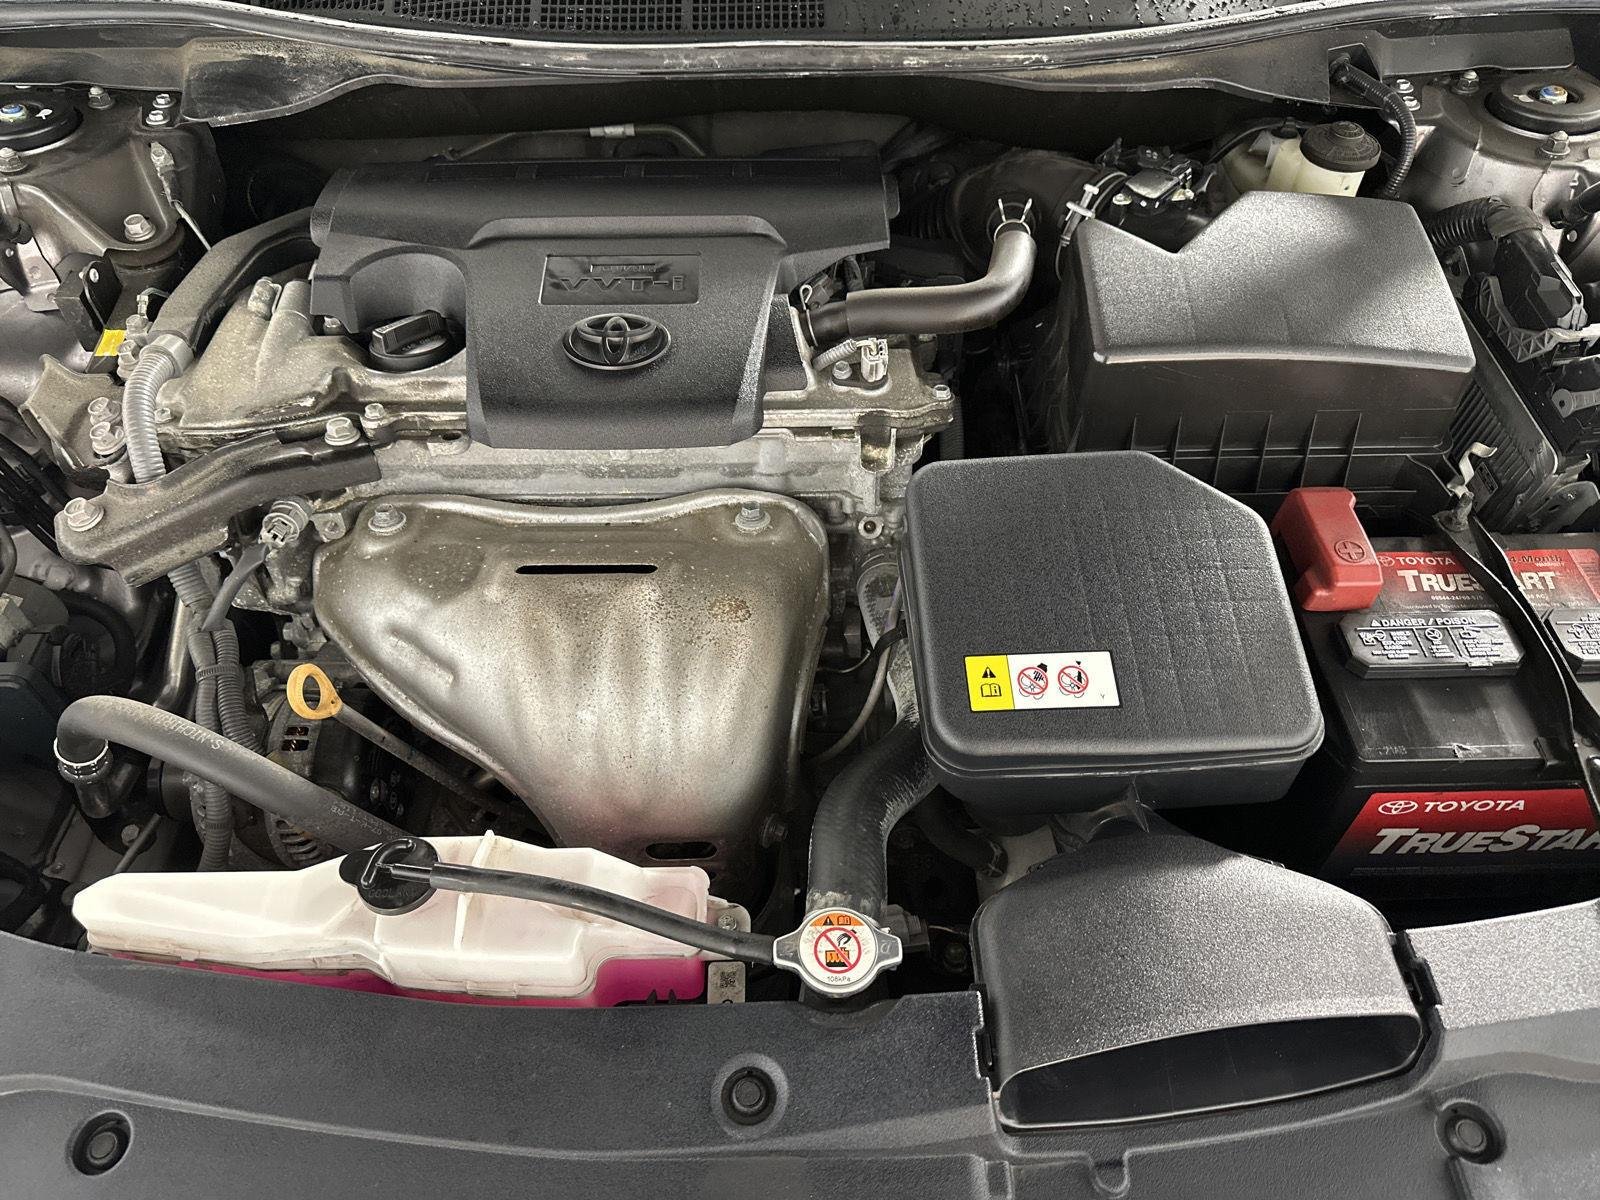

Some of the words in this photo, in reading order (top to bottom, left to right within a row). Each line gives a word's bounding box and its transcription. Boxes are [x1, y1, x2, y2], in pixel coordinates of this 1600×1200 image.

[560, 276, 686, 292] VVT-i
[1394, 556, 1456, 567] TOYOTA
[1382, 618, 1425, 627] DANGER
[1436, 617, 1476, 626] POISON
[1424, 800, 1525, 813] TOYOTA
[827, 975, 851, 983] 108kPa
